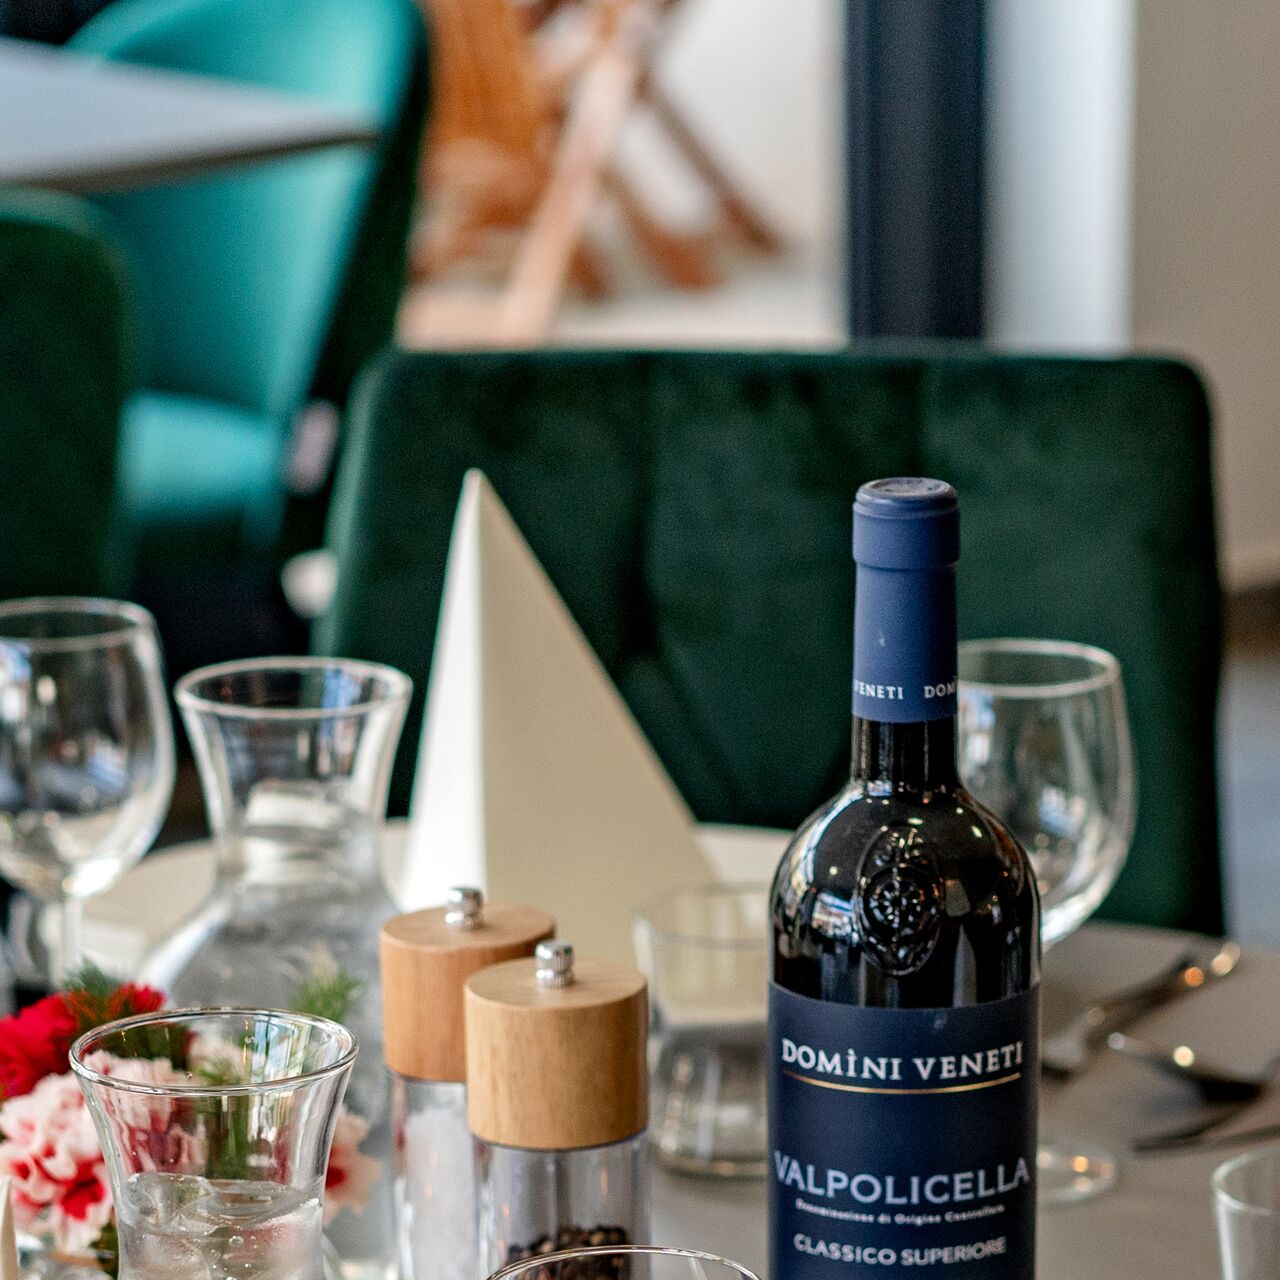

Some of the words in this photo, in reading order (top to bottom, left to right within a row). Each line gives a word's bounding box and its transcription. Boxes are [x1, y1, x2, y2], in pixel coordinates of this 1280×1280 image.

[781, 1037, 903, 1081] DOMÌNI
[911, 1040, 1023, 1081] VENETI
[773, 1150, 1030, 1205] VALPOLICELLA
[877, 1212, 891, 1225] di
[793, 1233, 897, 1266] CLASSICO
[901, 1236, 1007, 1266] SUPERIORE
